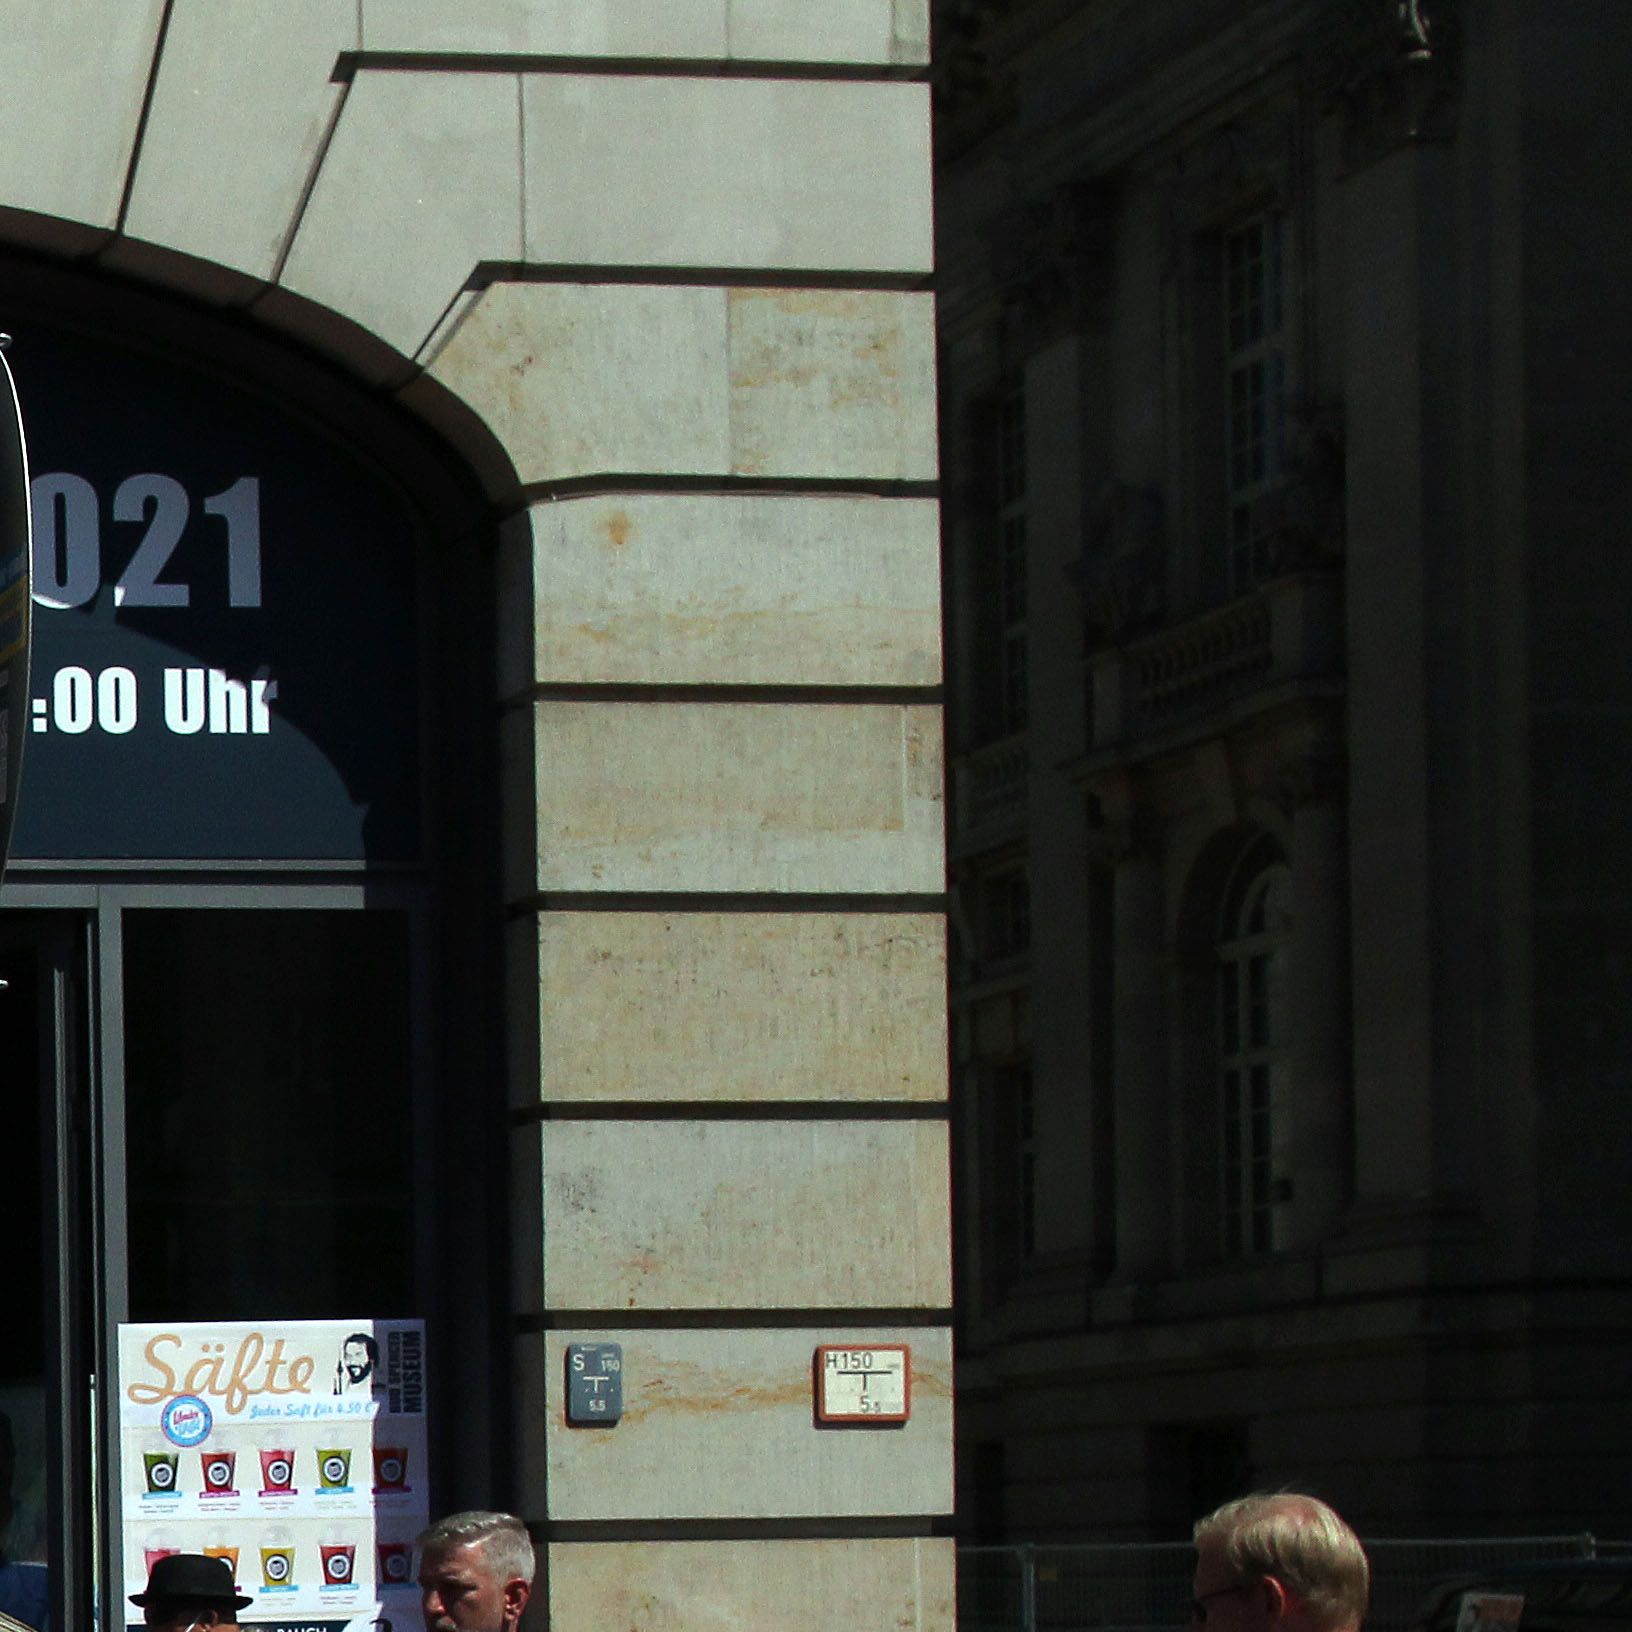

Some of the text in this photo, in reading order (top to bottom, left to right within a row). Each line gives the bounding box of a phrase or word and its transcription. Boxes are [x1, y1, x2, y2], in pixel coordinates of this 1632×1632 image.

[32, 472, 261, 610] 021
[32, 667, 137, 735] :00
[165, 669, 277, 735] Uhr
[127, 1332, 315, 1415] Säfte
[573, 1354, 585, 1371] S
